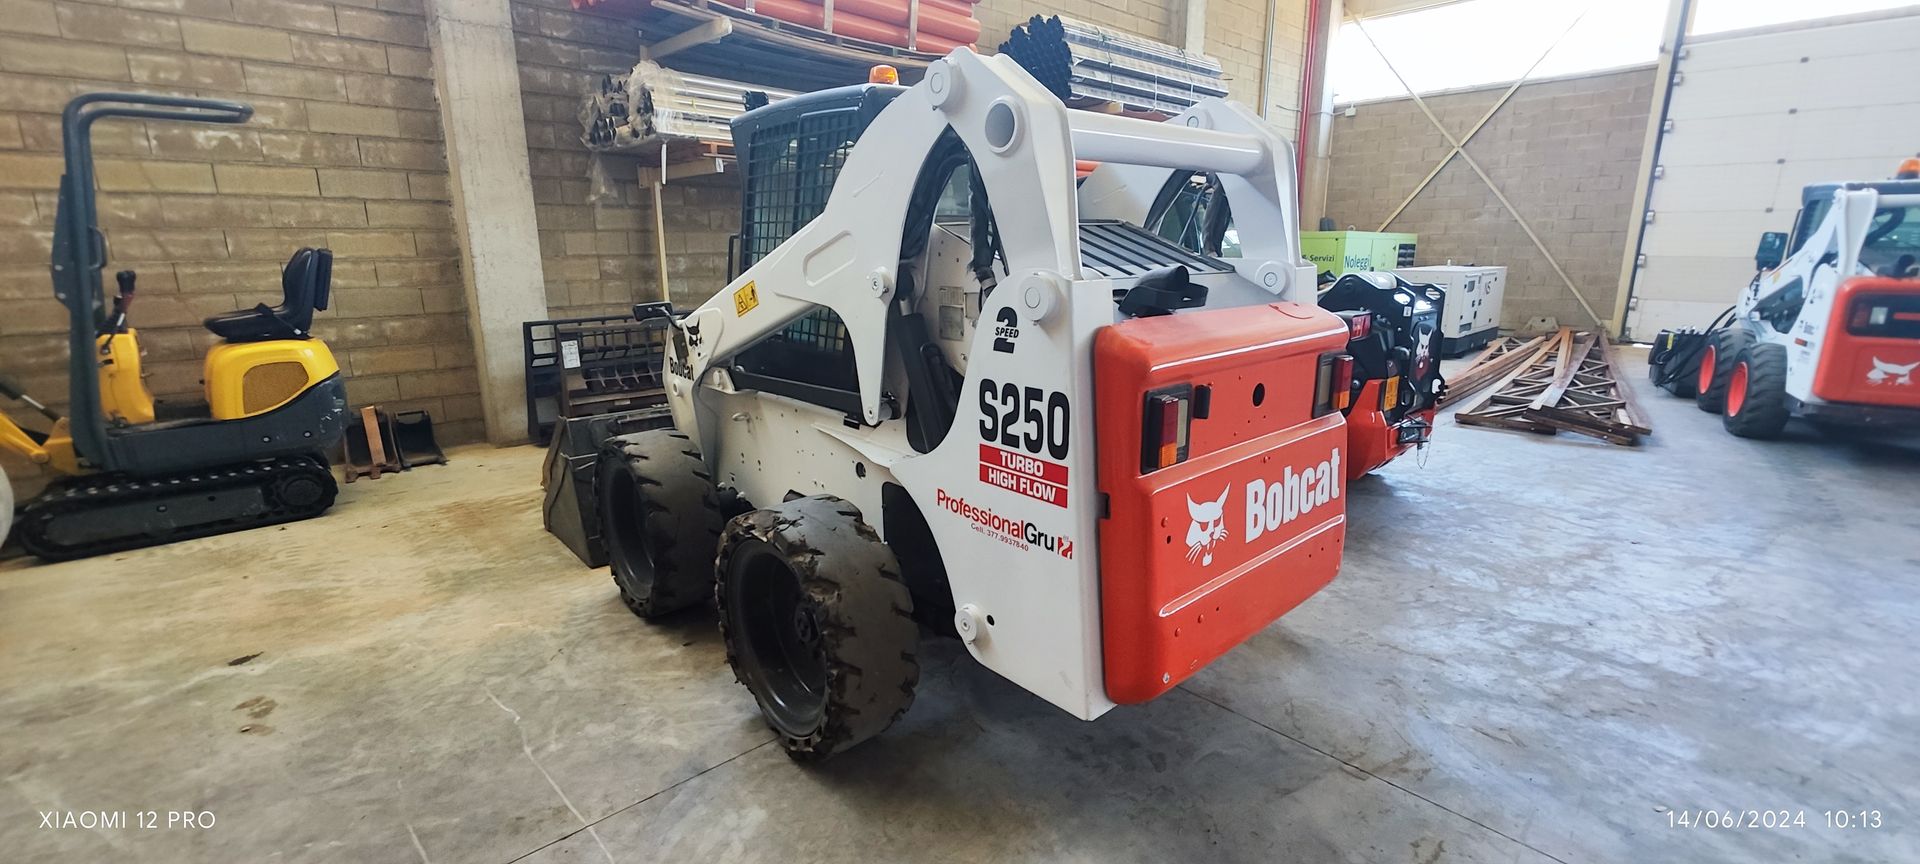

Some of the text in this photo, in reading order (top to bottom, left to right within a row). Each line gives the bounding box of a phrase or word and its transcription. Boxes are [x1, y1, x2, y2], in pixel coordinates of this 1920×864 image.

[1309, 254, 1335, 262] Servizi
[1344, 254, 1371, 271] Noleggi
[993, 306, 1018, 354] 2
[994, 326, 1019, 339] SPEED
[979, 378, 1070, 461] S250
[1000, 450, 1044, 477] TURBO
[988, 467, 1057, 503] HIGH FLOW
[1245, 447, 1340, 544] Bobcat
[936, 487, 1055, 552] ProfessionalGru
